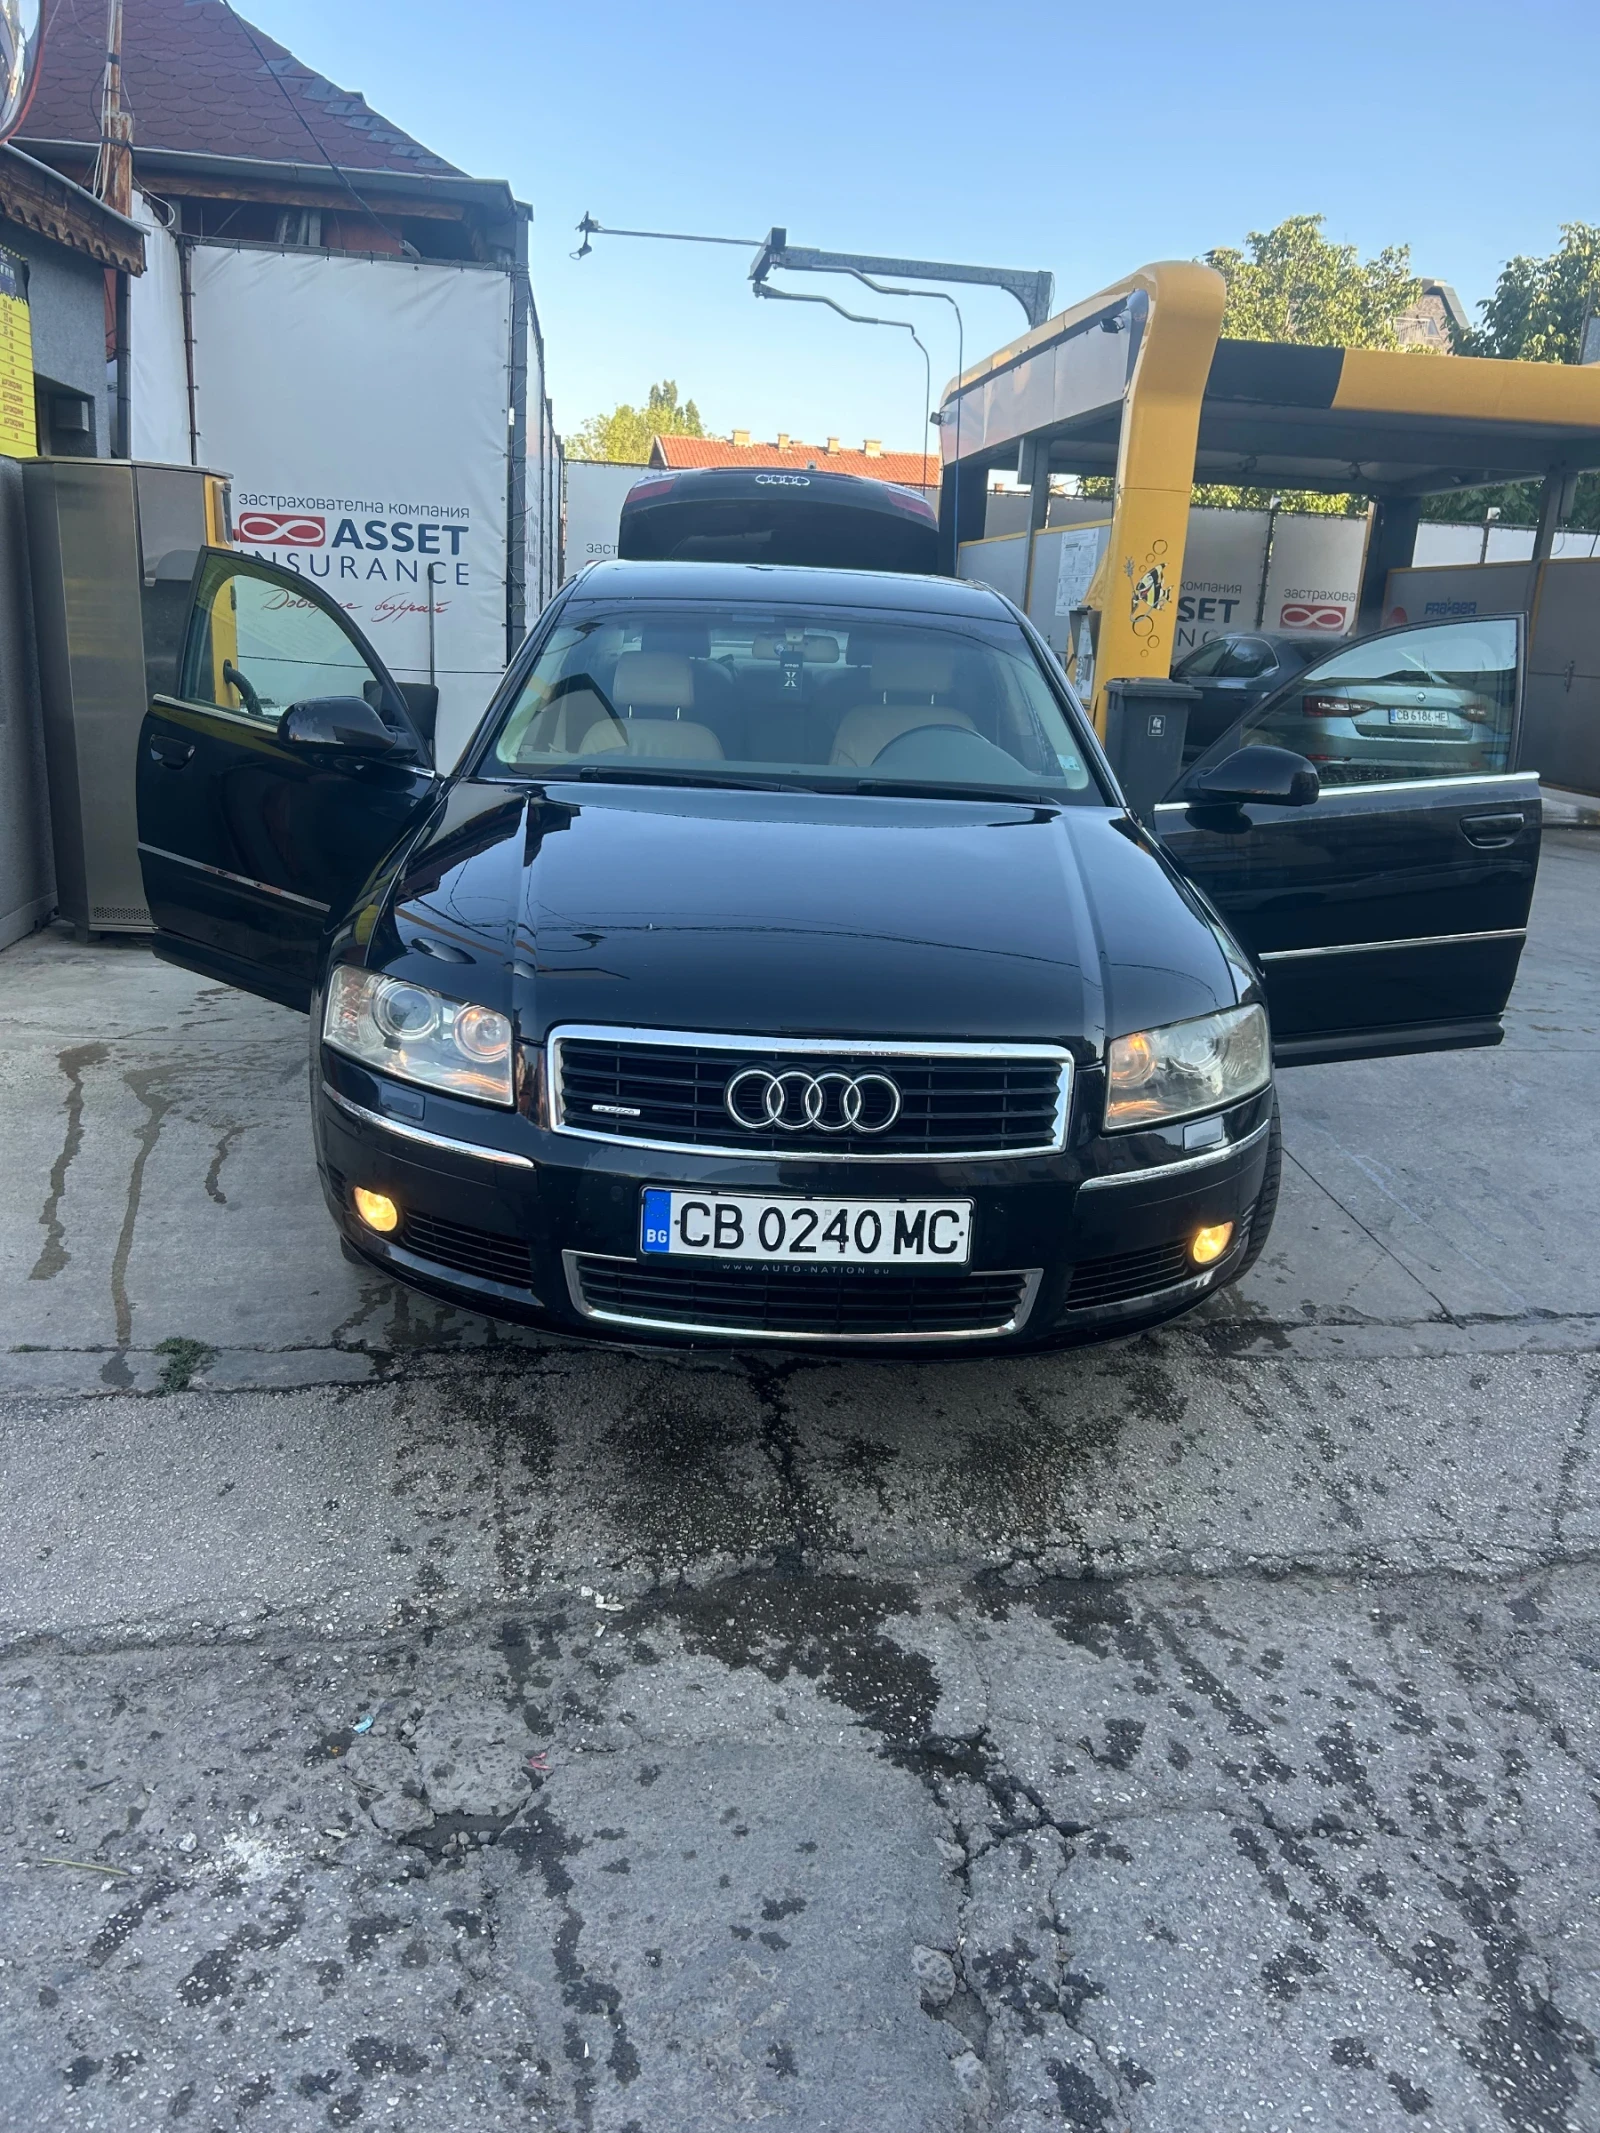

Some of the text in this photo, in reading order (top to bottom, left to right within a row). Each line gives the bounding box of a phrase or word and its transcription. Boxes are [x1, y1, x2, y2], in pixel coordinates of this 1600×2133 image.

[239, 493, 470, 518] застрахователна компания
[331, 518, 469, 555] ASSET
[239, 549, 470, 586] NSURANCE
[1177, 596, 1240, 624] SET
[1283, 588, 1357, 602] застрахова
[646, 1201, 960, 1255] BG CB 0240 MC
